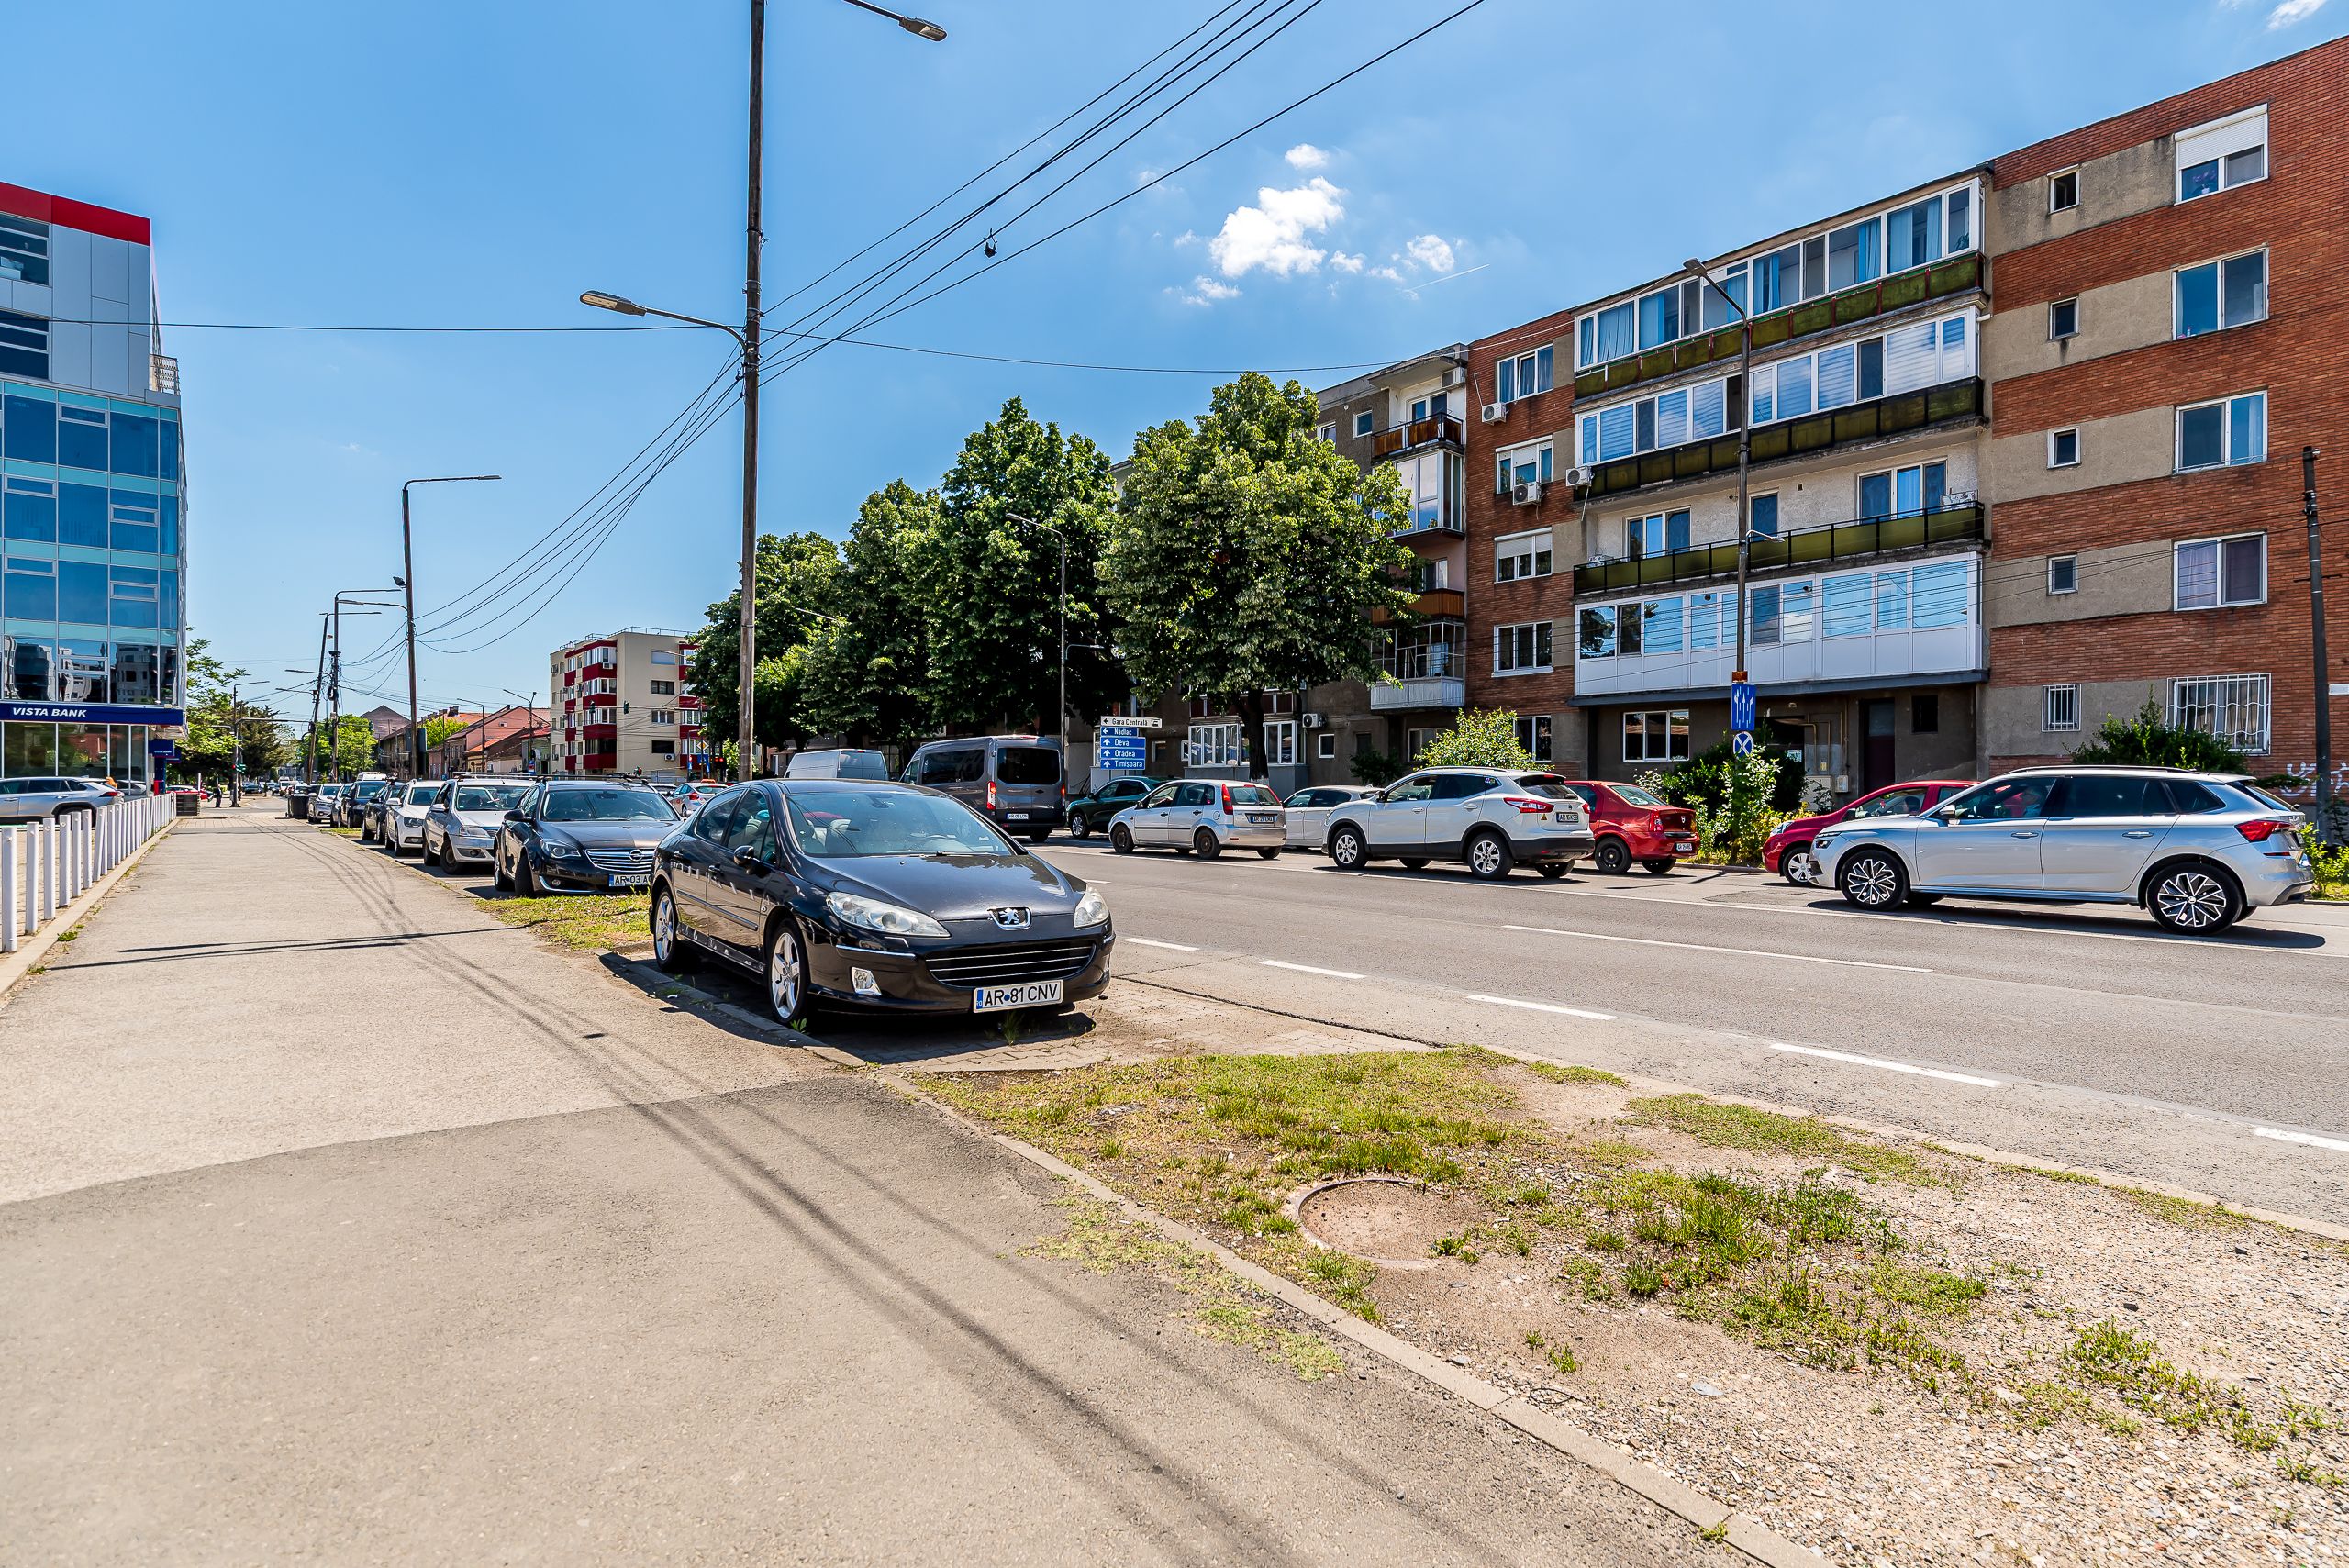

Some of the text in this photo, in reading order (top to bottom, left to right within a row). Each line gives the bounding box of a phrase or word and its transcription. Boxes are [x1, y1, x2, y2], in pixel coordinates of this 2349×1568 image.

[12, 707, 87, 717] VISTA BANK
[1111, 717, 1125, 726] Gara
[1114, 738, 1130, 747] Deva
[1114, 749, 1136, 758] Oradea
[615, 875, 627, 884] AR
[629, 875, 641, 884] 03
[985, 989, 1004, 1006] AR
[1010, 987, 1024, 1003] 81
[1028, 984, 1058, 1001] CNV
